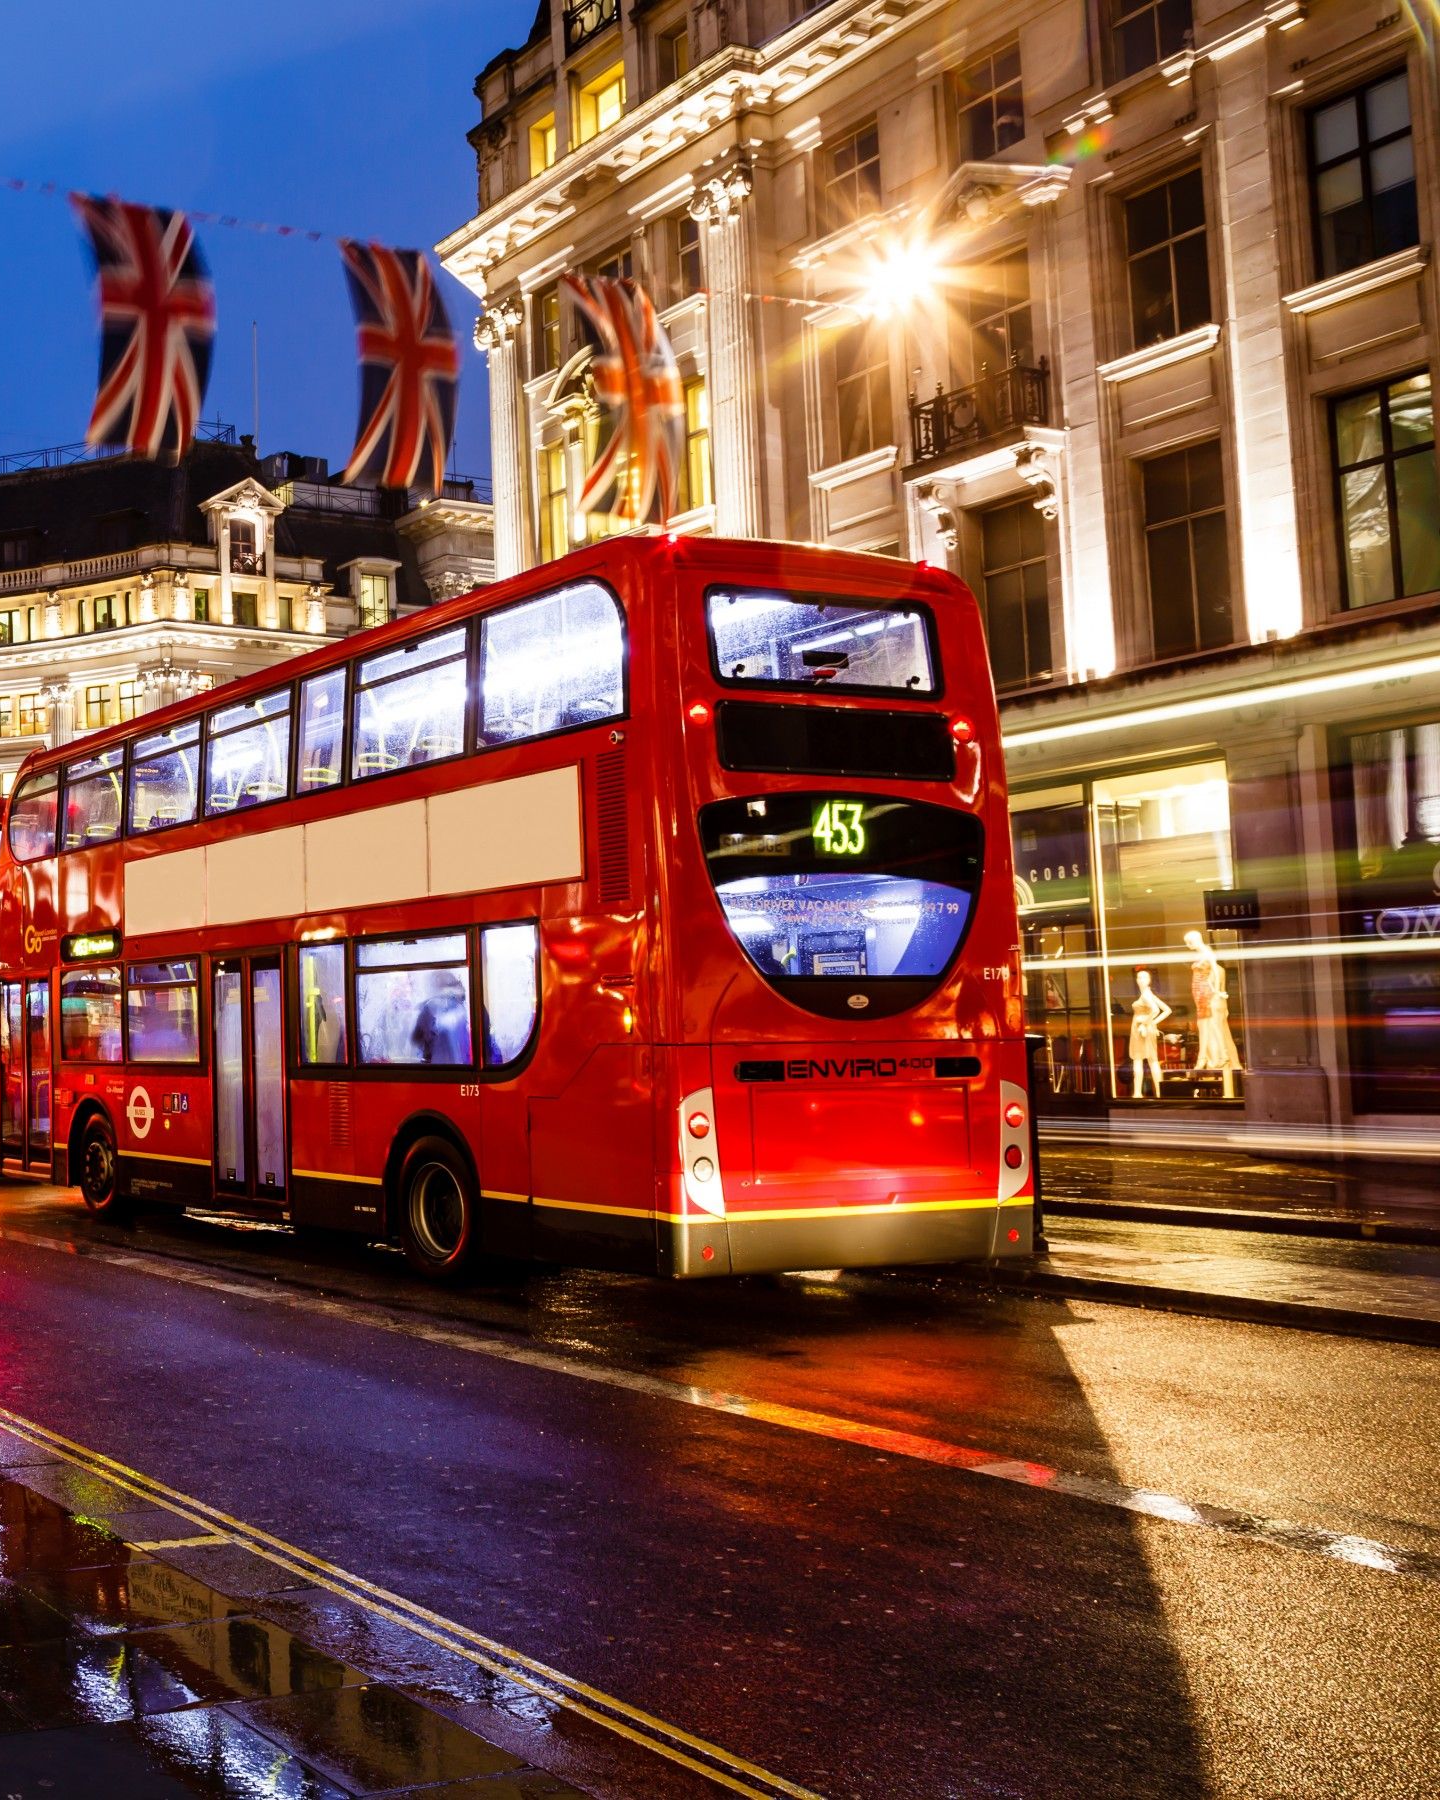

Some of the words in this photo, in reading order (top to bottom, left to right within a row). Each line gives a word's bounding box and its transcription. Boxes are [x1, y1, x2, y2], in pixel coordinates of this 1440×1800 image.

[813, 801, 865, 854] 453
[1215, 903, 1253, 915] coast
[787, 1058, 897, 1079] ENVIRO
[899, 1057, 933, 1069] 400
[460, 1084, 480, 1097] E173
